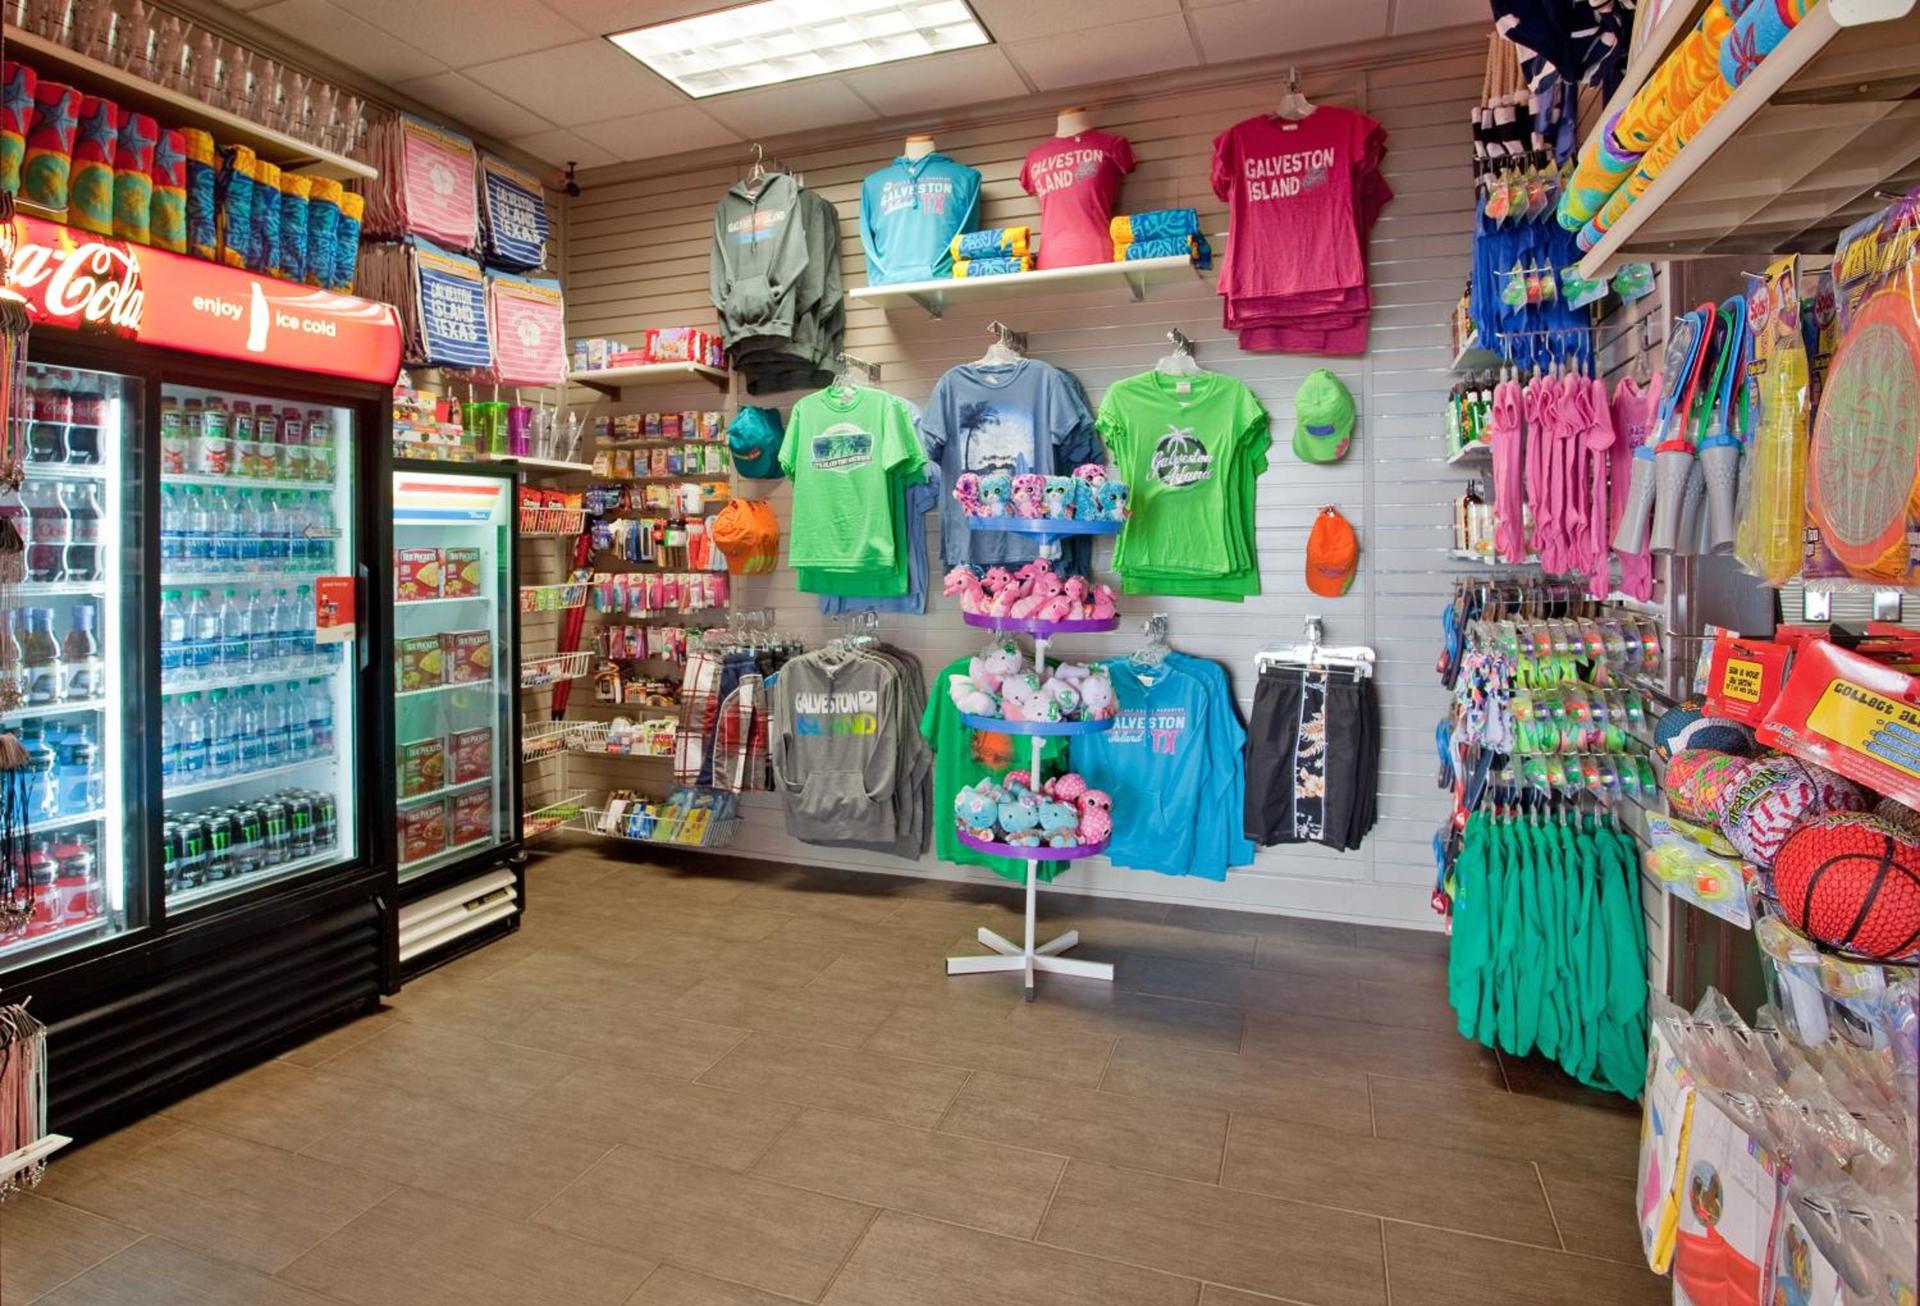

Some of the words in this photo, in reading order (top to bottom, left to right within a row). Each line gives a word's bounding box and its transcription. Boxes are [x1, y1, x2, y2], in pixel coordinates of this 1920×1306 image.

[1245, 147, 1334, 179] GALVESTON
[1246, 176, 1300, 202] ISLAND
[922, 193, 945, 215] TX
[192, 294, 243, 320] enjoy
[275, 310, 300, 331] ice
[302, 318, 337, 338] cold
[434, 317, 479, 342] TEXAS
[795, 692, 859, 714] GALVESTON
[1112, 715, 1185, 731] ALVESTON
[1151, 729, 1178, 756] TX
